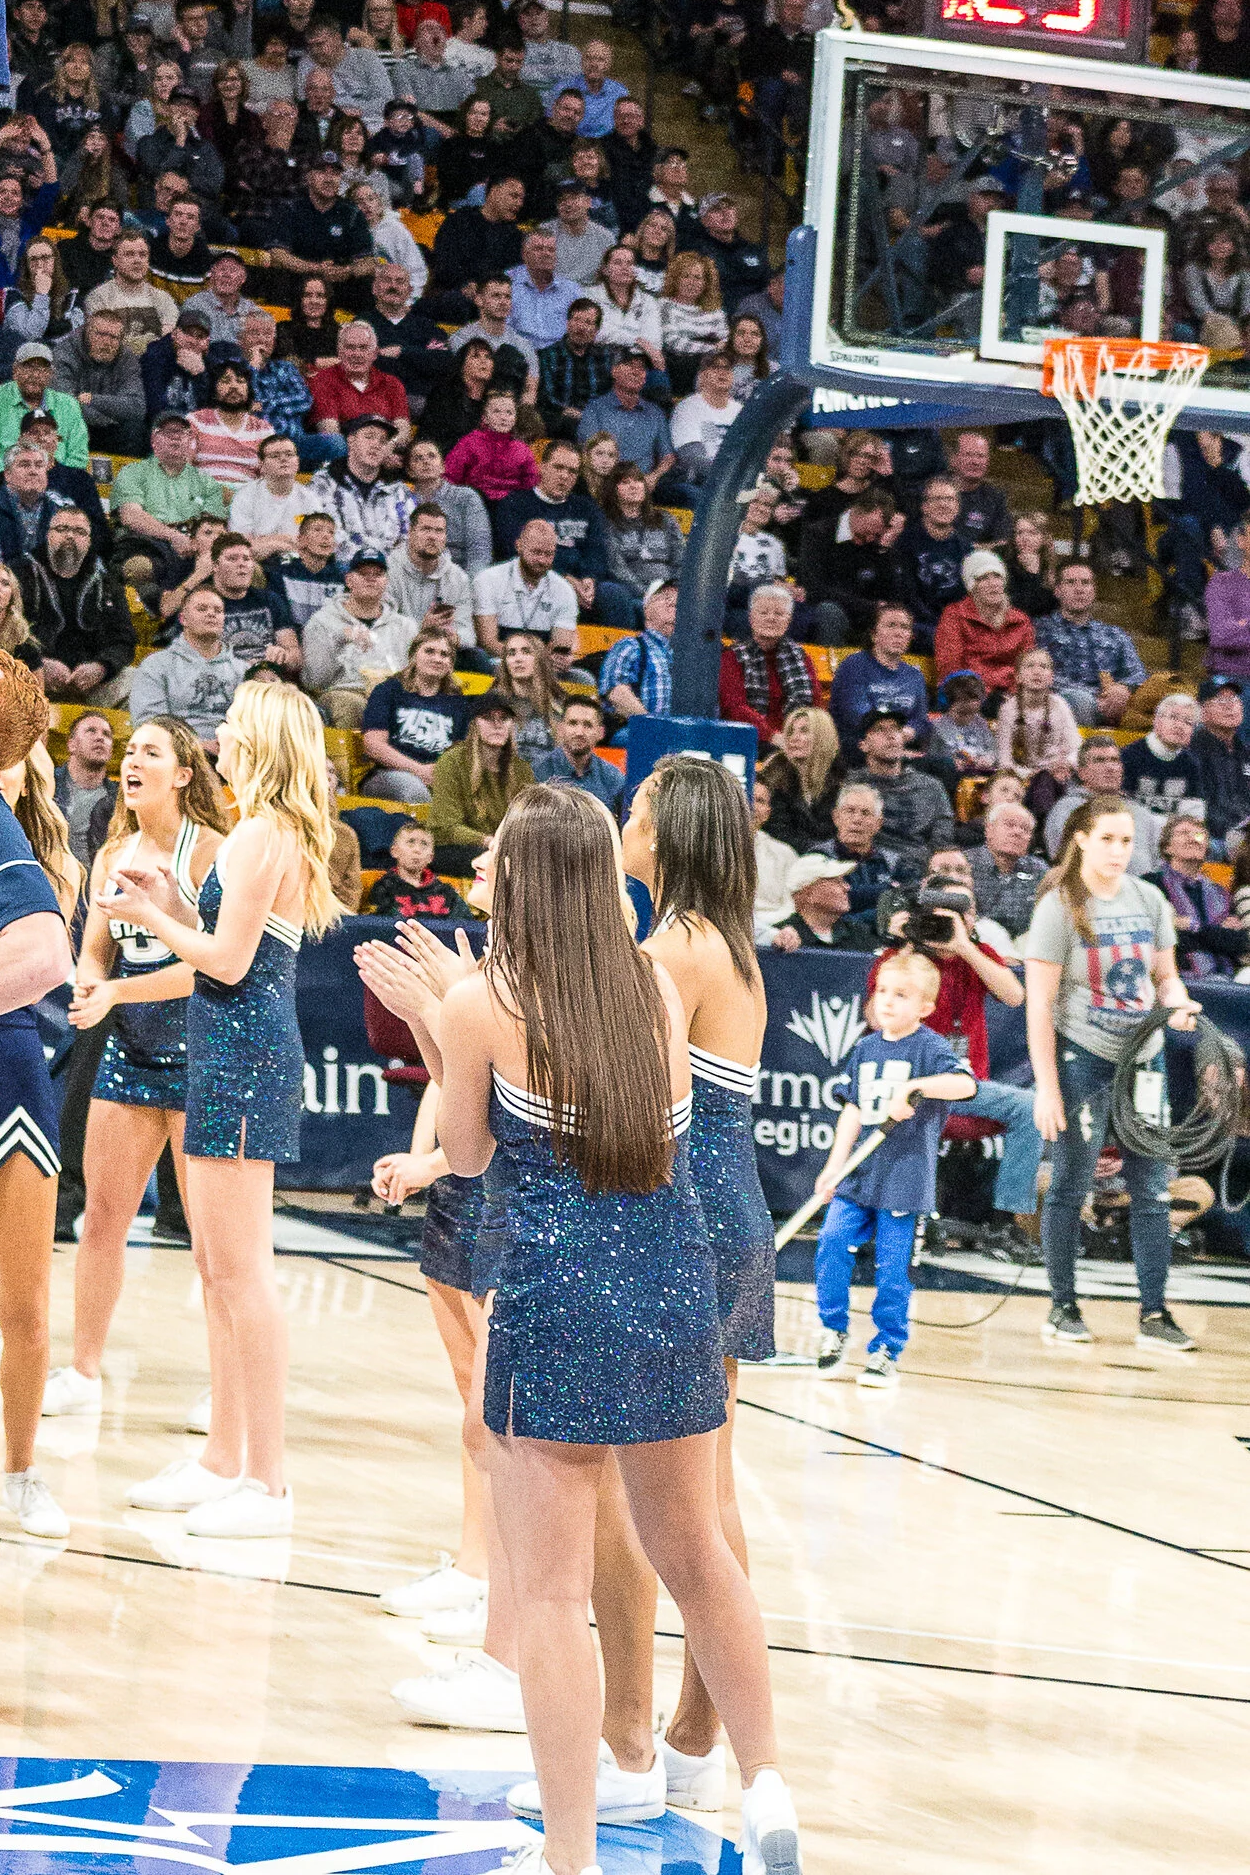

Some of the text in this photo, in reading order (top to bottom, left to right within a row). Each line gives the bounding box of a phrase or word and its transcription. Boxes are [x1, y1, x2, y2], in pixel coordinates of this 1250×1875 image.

[829, 350, 880, 367] SPALDING
[301, 1045, 390, 1115] ain
[754, 1112, 835, 1156] egio
